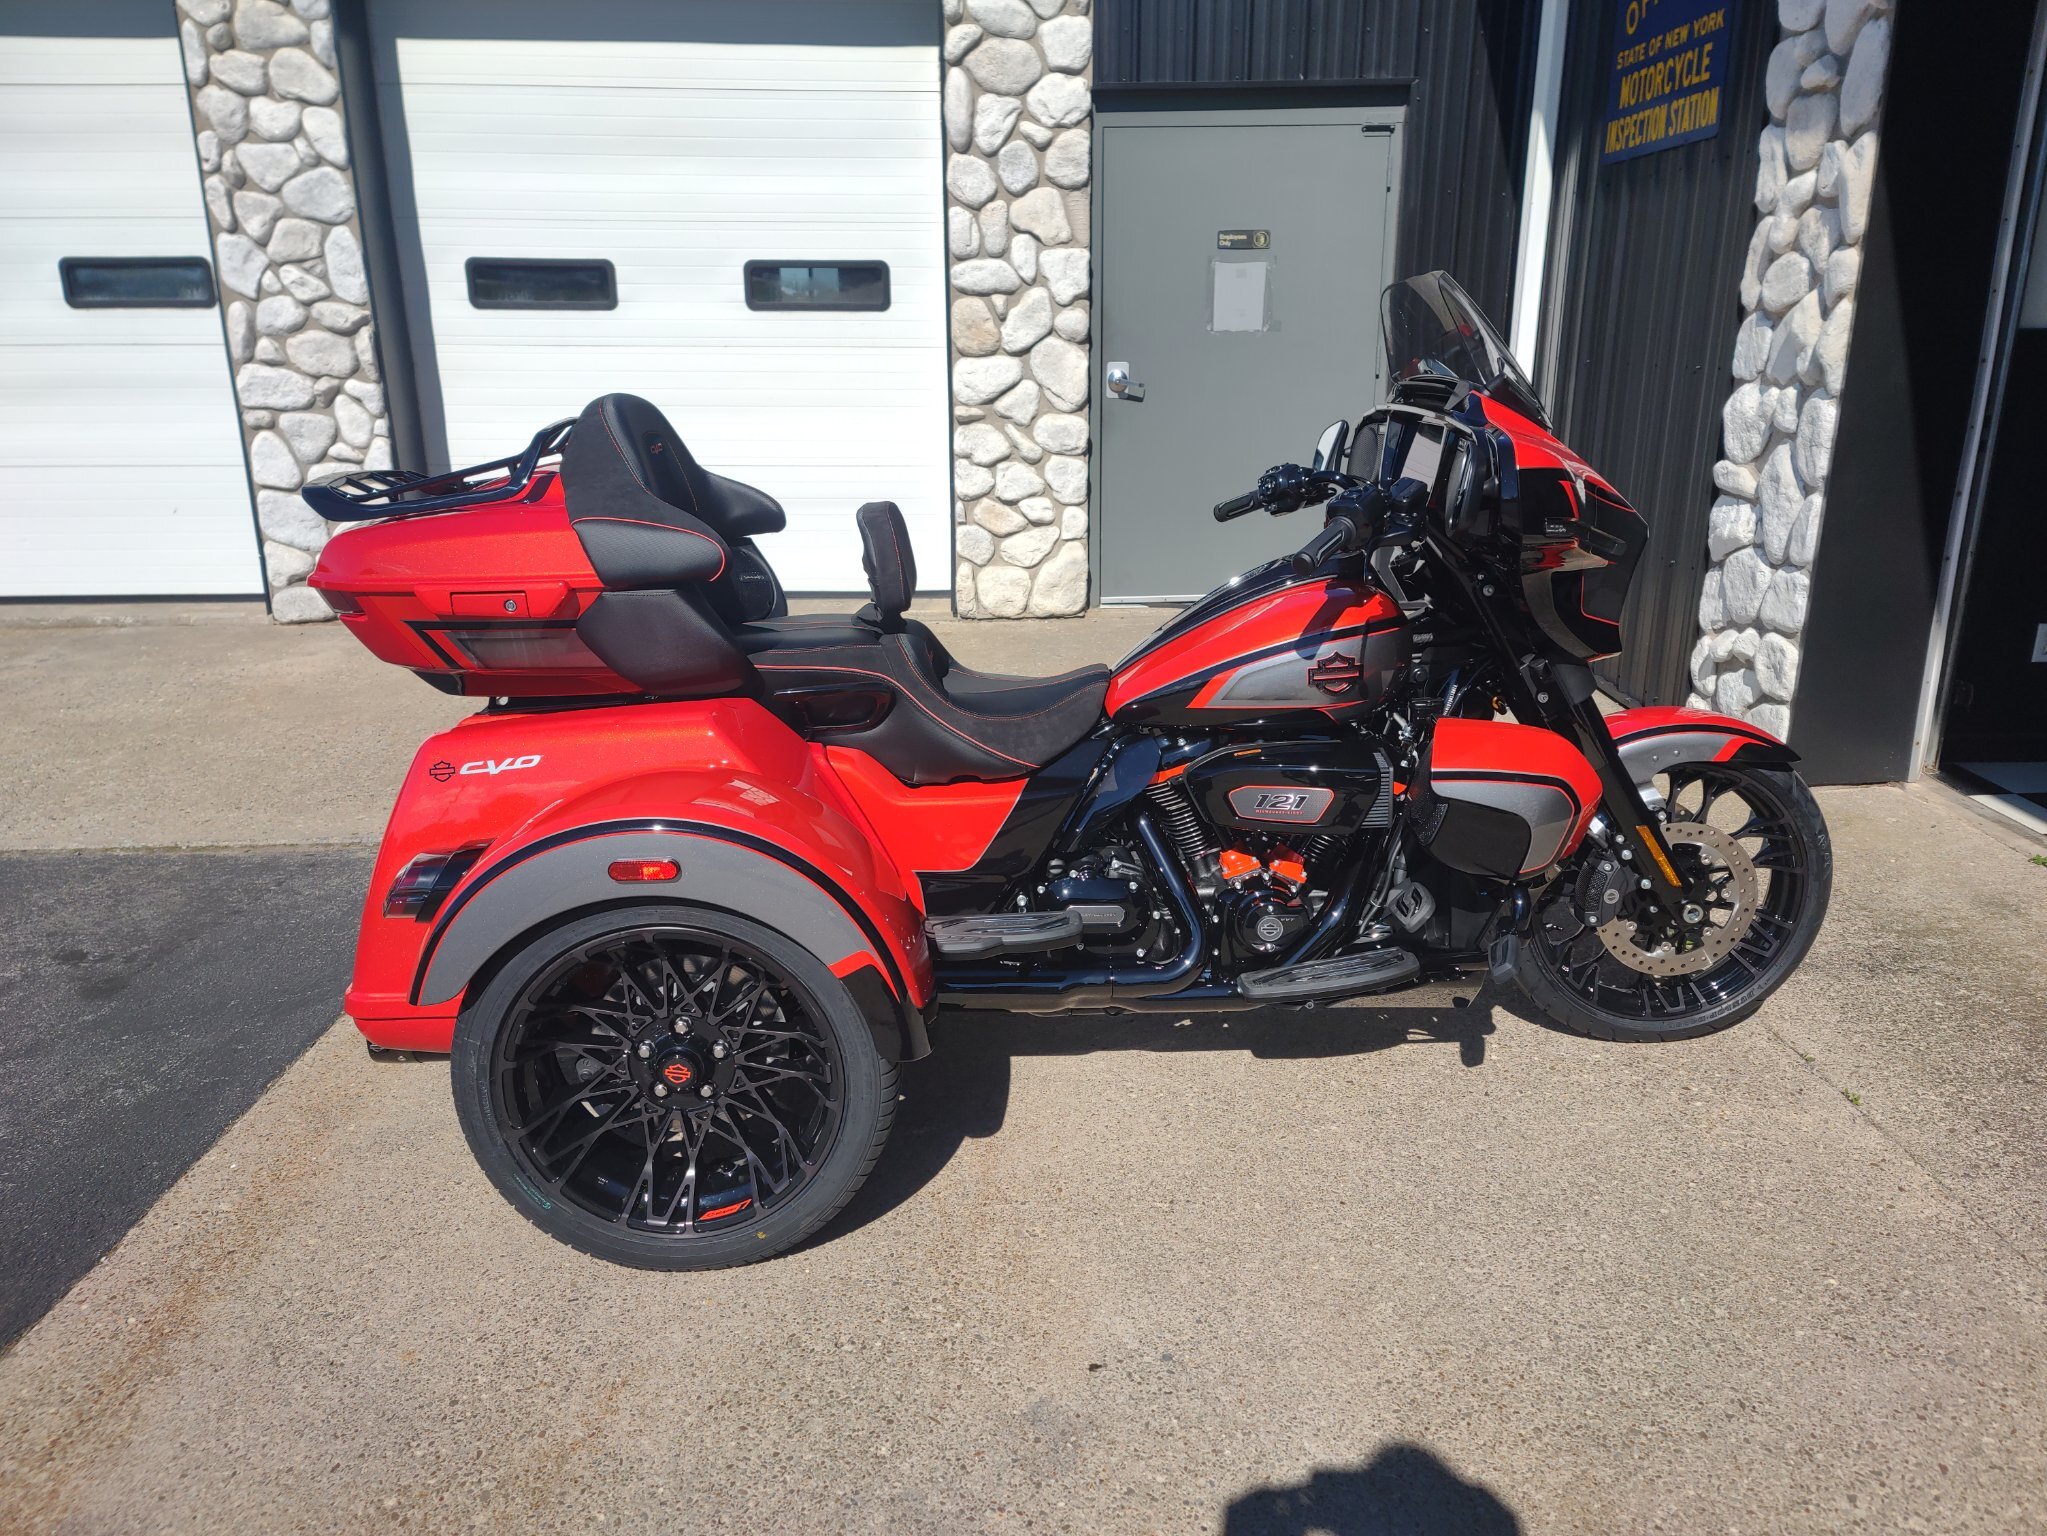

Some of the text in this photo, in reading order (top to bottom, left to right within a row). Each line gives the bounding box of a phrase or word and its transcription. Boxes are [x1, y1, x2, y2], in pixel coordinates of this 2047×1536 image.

[1616, 8, 1725, 69] STATE OF NEW YORK
[1619, 42, 1713, 109] MOTORCYCLE
[1604, 86, 1720, 154] INSPECTION STATION
[459, 754, 542, 774] CVO
[1254, 793, 1309, 810] 121
